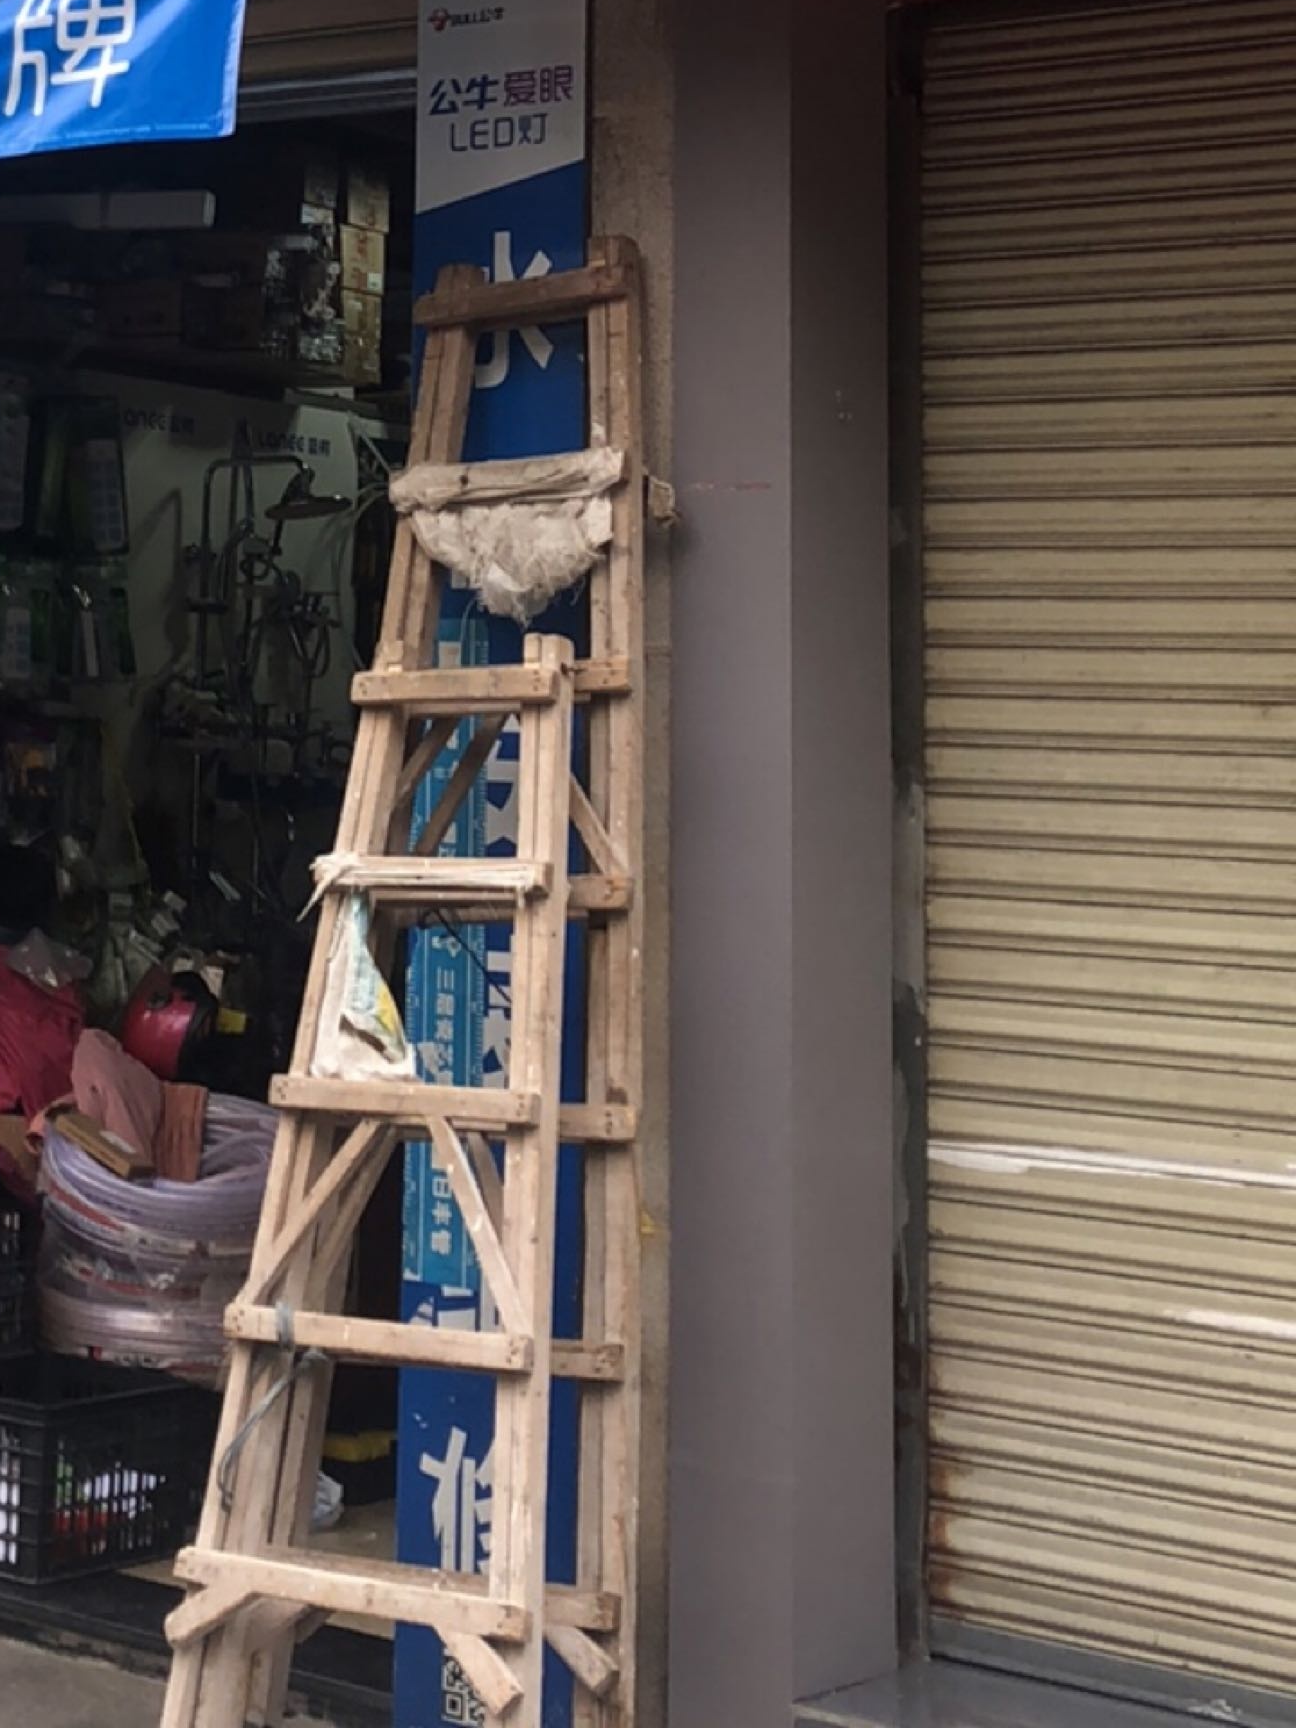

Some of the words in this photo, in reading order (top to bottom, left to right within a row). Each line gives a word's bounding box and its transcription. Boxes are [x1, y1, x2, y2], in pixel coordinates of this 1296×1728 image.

[429, 64, 574, 116] 公牛爱眼
[449, 113, 549, 152] LED灯
